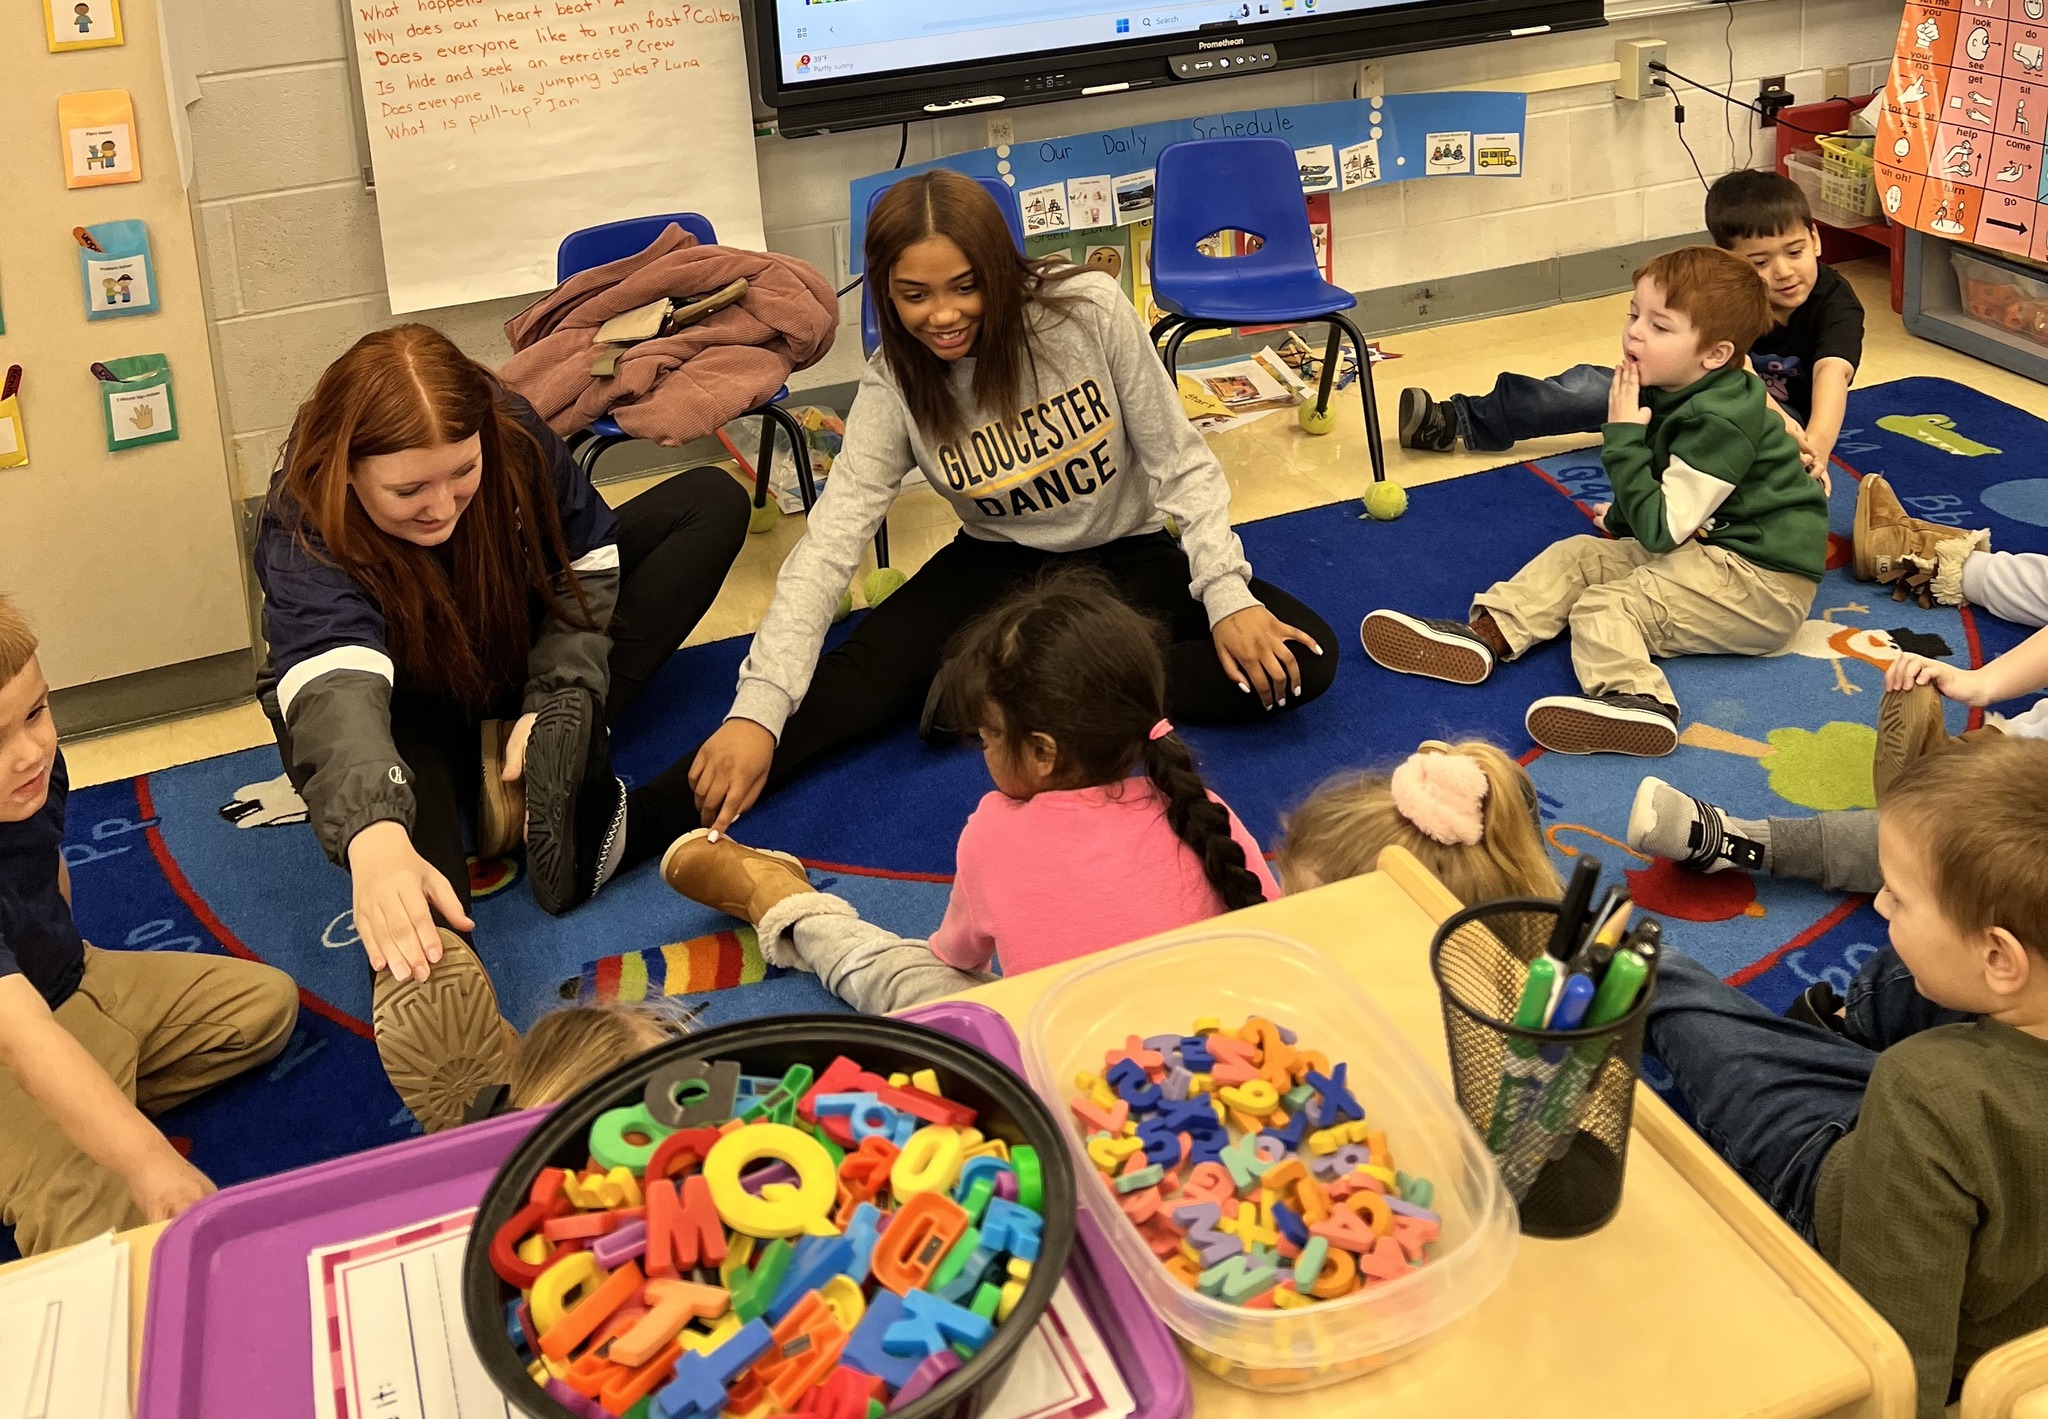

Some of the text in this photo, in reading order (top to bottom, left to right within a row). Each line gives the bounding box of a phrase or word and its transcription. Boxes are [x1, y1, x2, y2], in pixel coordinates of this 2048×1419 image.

[360, 1, 400, 22] What
[1922, 7, 1942, 17] you
[363, 28, 394, 46] Why
[406, 23, 443, 38] does
[453, 18, 478, 30] our
[495, 5, 543, 22] heart
[1156, 16, 1179, 25] Search
[1972, 17, 1992, 28] look
[375, 50, 423, 67] Does
[437, 38, 519, 58] everyone
[536, 26, 567, 43] like
[579, 23, 597, 37] to
[609, 22, 640, 36] run
[693, 9, 740, 24] Colton
[2025, 29, 2037, 39] do
[1198, 37, 1245, 50] Promethean
[1910, 50, 1933, 61] your
[375, 80, 396, 96] Is
[406, 73, 437, 90] hide
[445, 65, 474, 84] and
[481, 57, 513, 77] seek
[528, 58, 548, 69] an
[637, 38, 675, 54] Crew
[813, 64, 833, 72] Partly
[1915, 61, 1929, 71] no
[1968, 61, 1985, 71] see
[1968, 74, 1983, 85] get
[381, 101, 413, 118] Does
[418, 91, 482, 111] everyone
[500, 79, 525, 95] like
[536, 73, 601, 96] jumping
[665, 58, 700, 72] Luna
[2019, 84, 2031, 95] sit
[384, 119, 426, 140] What
[442, 116, 457, 130] is
[1956, 127, 1978, 140] help
[1039, 107, 1294, 163] Our Daily Schedule
[2006, 139, 2031, 151] come
[1881, 167, 1912, 183] uh oh!
[1944, 183, 1965, 195] turn
[2004, 197, 2017, 206] go
[938, 379, 1111, 491] GLOUCESTER
[973, 438, 1117, 517] DANCE
